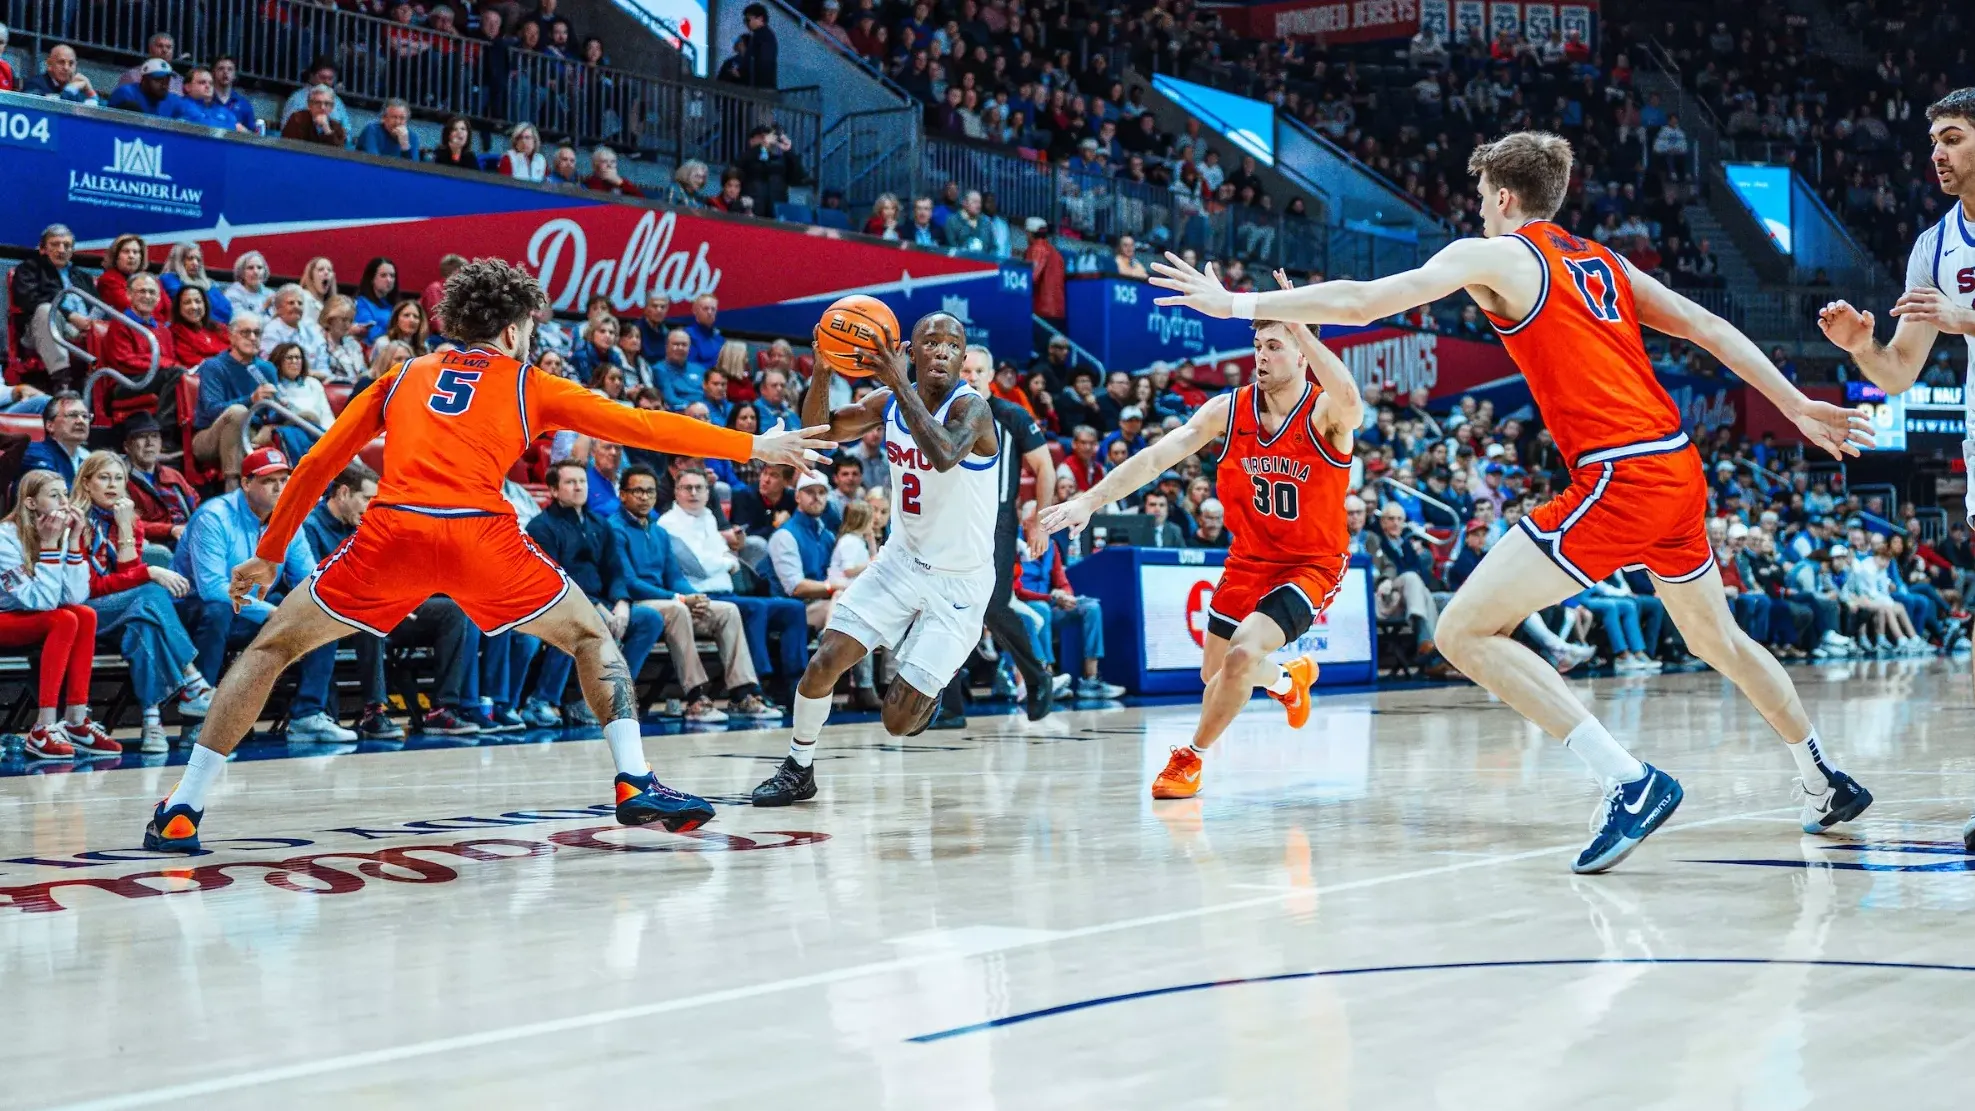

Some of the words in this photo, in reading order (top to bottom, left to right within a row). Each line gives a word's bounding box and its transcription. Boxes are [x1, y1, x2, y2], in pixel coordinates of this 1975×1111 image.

[0, 111, 51, 143] 104
[80, 171, 170, 199] ALEXANDER
[171, 183, 204, 203] LAW
[526, 210, 723, 313] Dallas
[1003, 269, 1029, 291] 104
[1114, 284, 1138, 306] 105
[1561, 256, 1623, 324] 17
[830, 315, 874, 342] ELITE
[1342, 331, 1438, 396] MUSTANGS
[427, 368, 483, 416] 5
[886, 440, 933, 472] SMU
[1240, 456, 1311, 482] VIRGINIA
[902, 473, 921, 515] 2
[1250, 474, 1299, 521] 30
